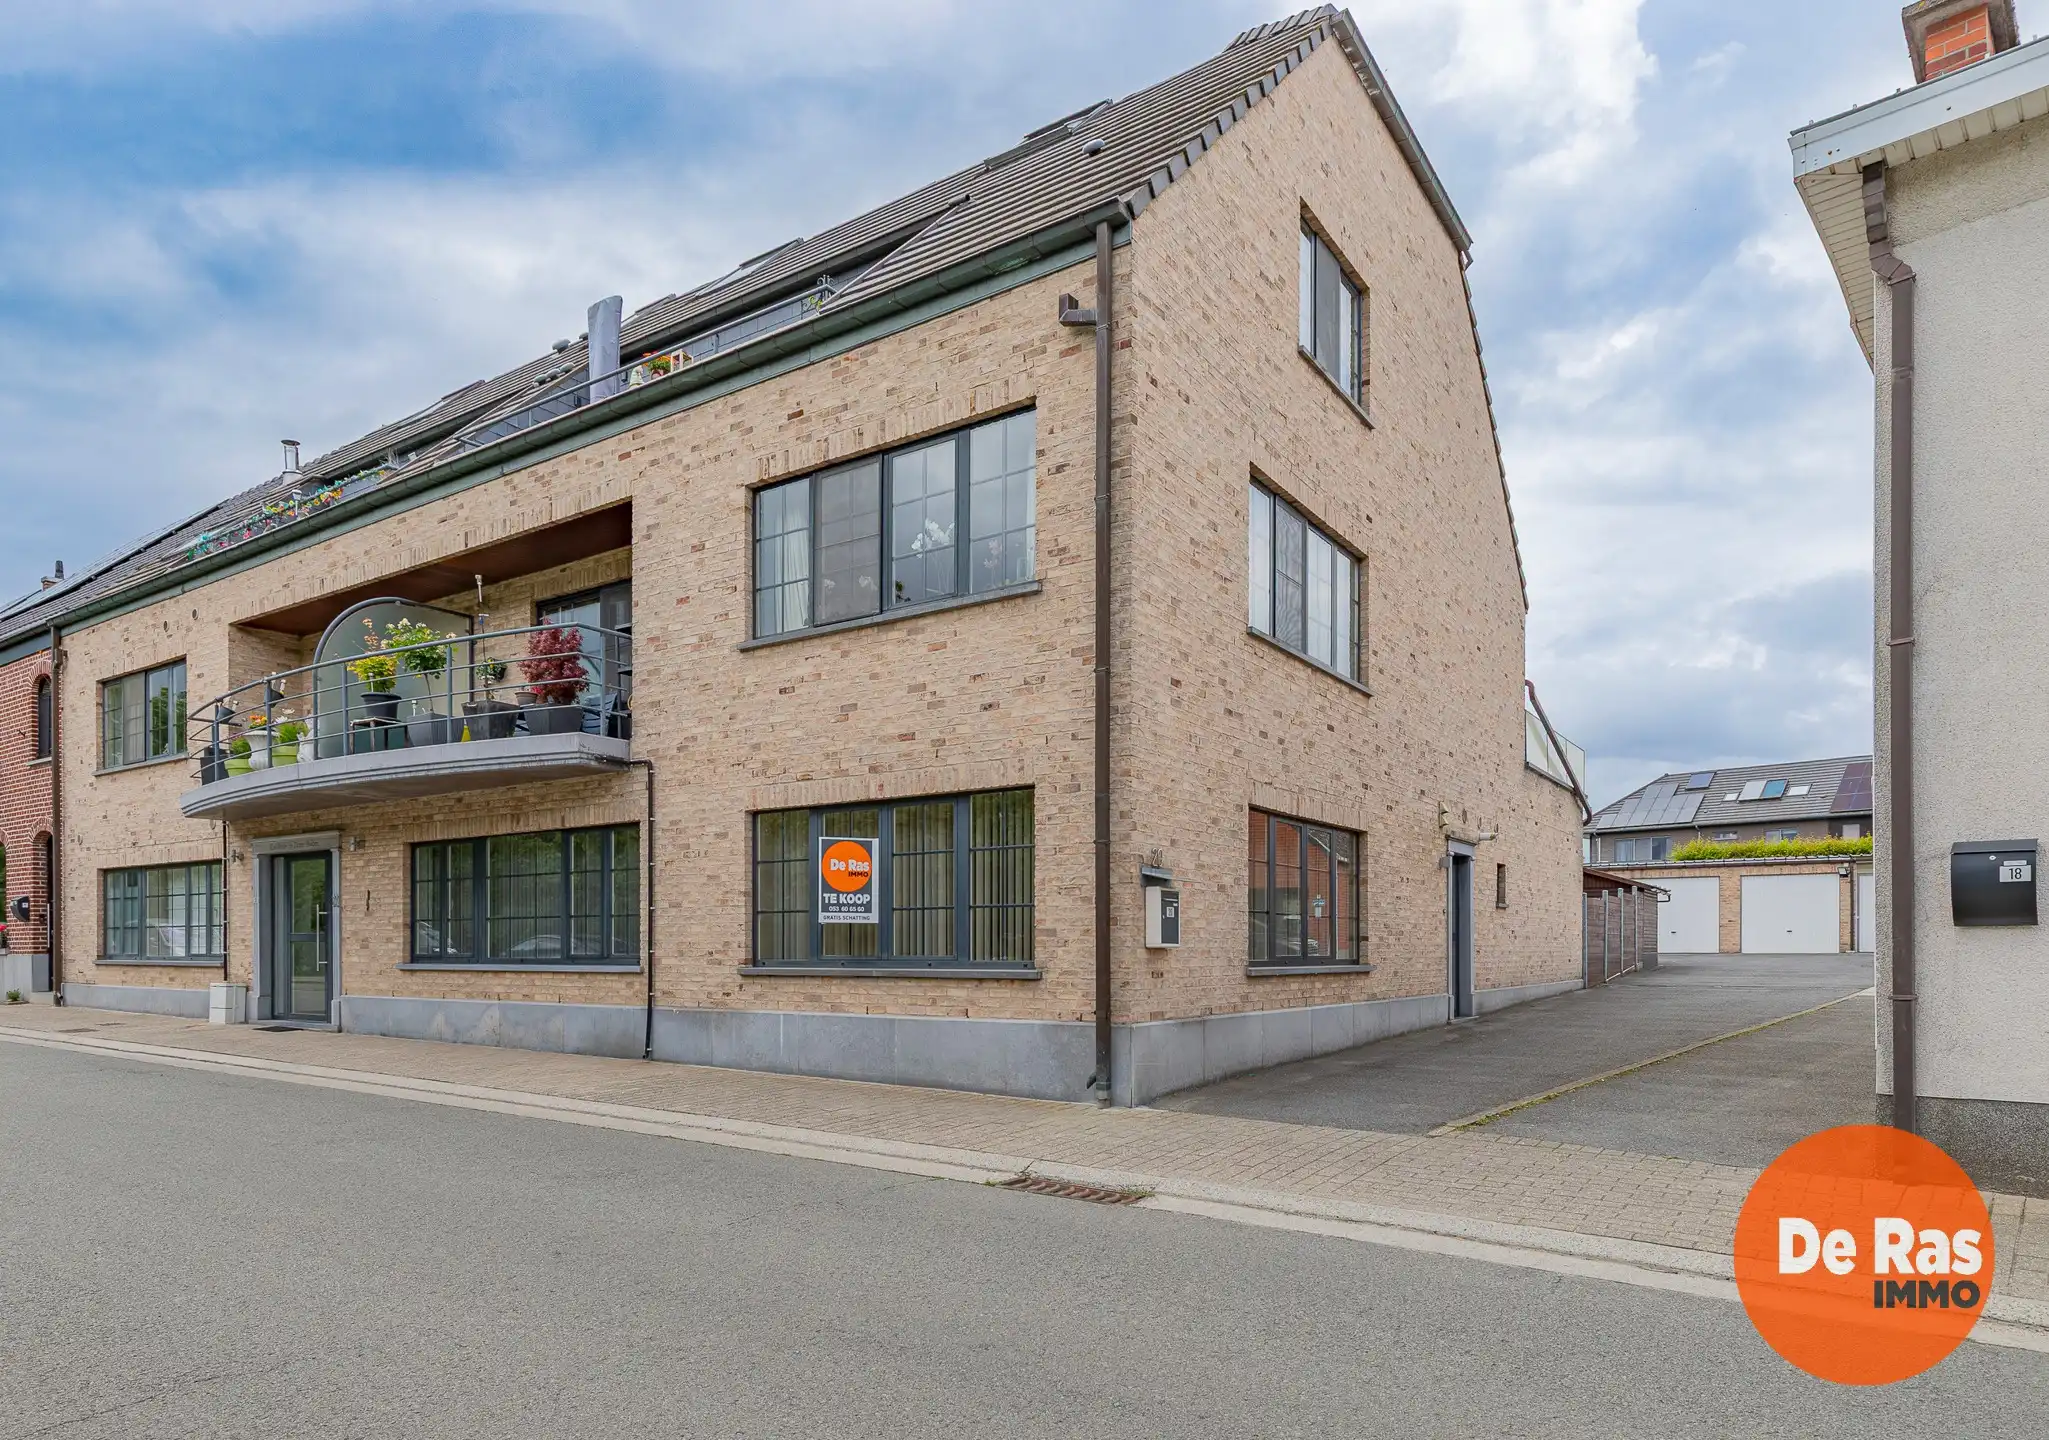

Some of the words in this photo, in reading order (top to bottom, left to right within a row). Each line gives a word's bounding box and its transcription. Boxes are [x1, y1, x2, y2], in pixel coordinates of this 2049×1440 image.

[830, 858, 846, 871] De
[848, 859, 869, 872] Ras
[2009, 868, 2022, 879] 18
[823, 893, 837, 904] TE
[839, 893, 870, 904] KOOP
